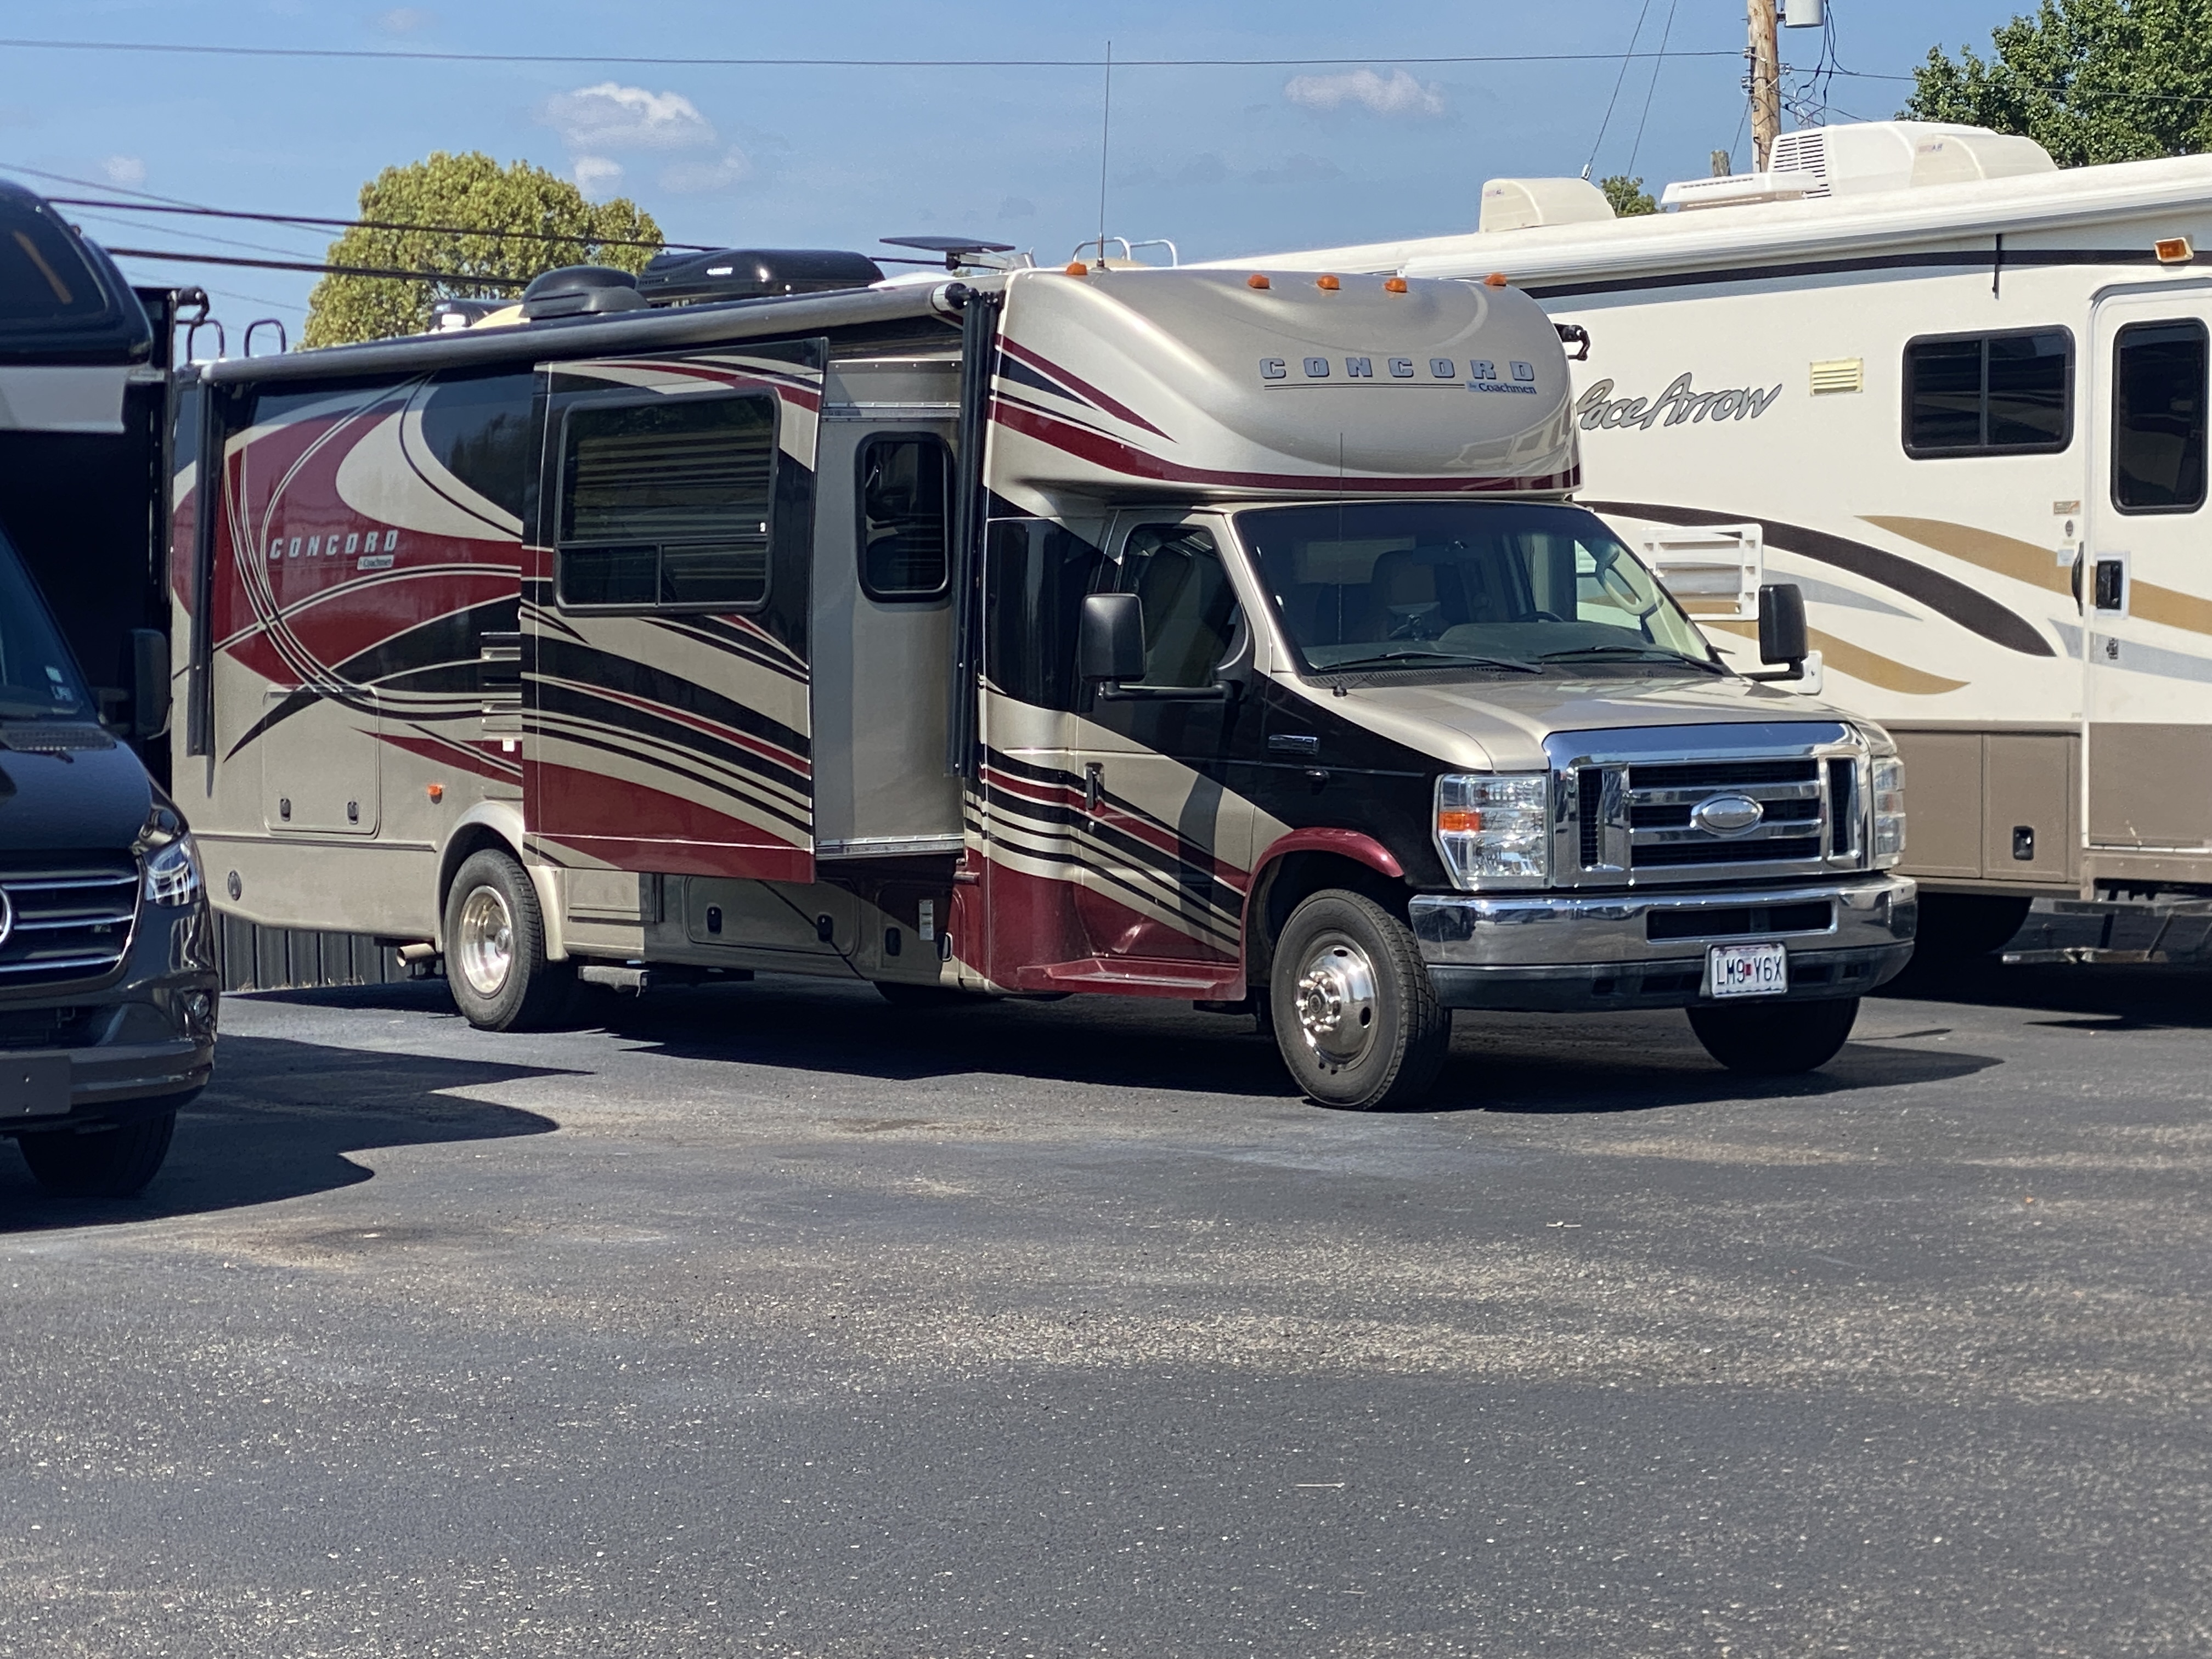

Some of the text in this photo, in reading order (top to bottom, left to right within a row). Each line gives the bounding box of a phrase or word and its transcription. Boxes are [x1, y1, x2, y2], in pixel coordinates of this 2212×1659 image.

[1259, 358, 1535, 381] CONCORD
[1479, 382, 1537, 394] Coachmen
[1640, 372, 1782, 430] Arrow
[269, 530, 398, 560] CONCORD
